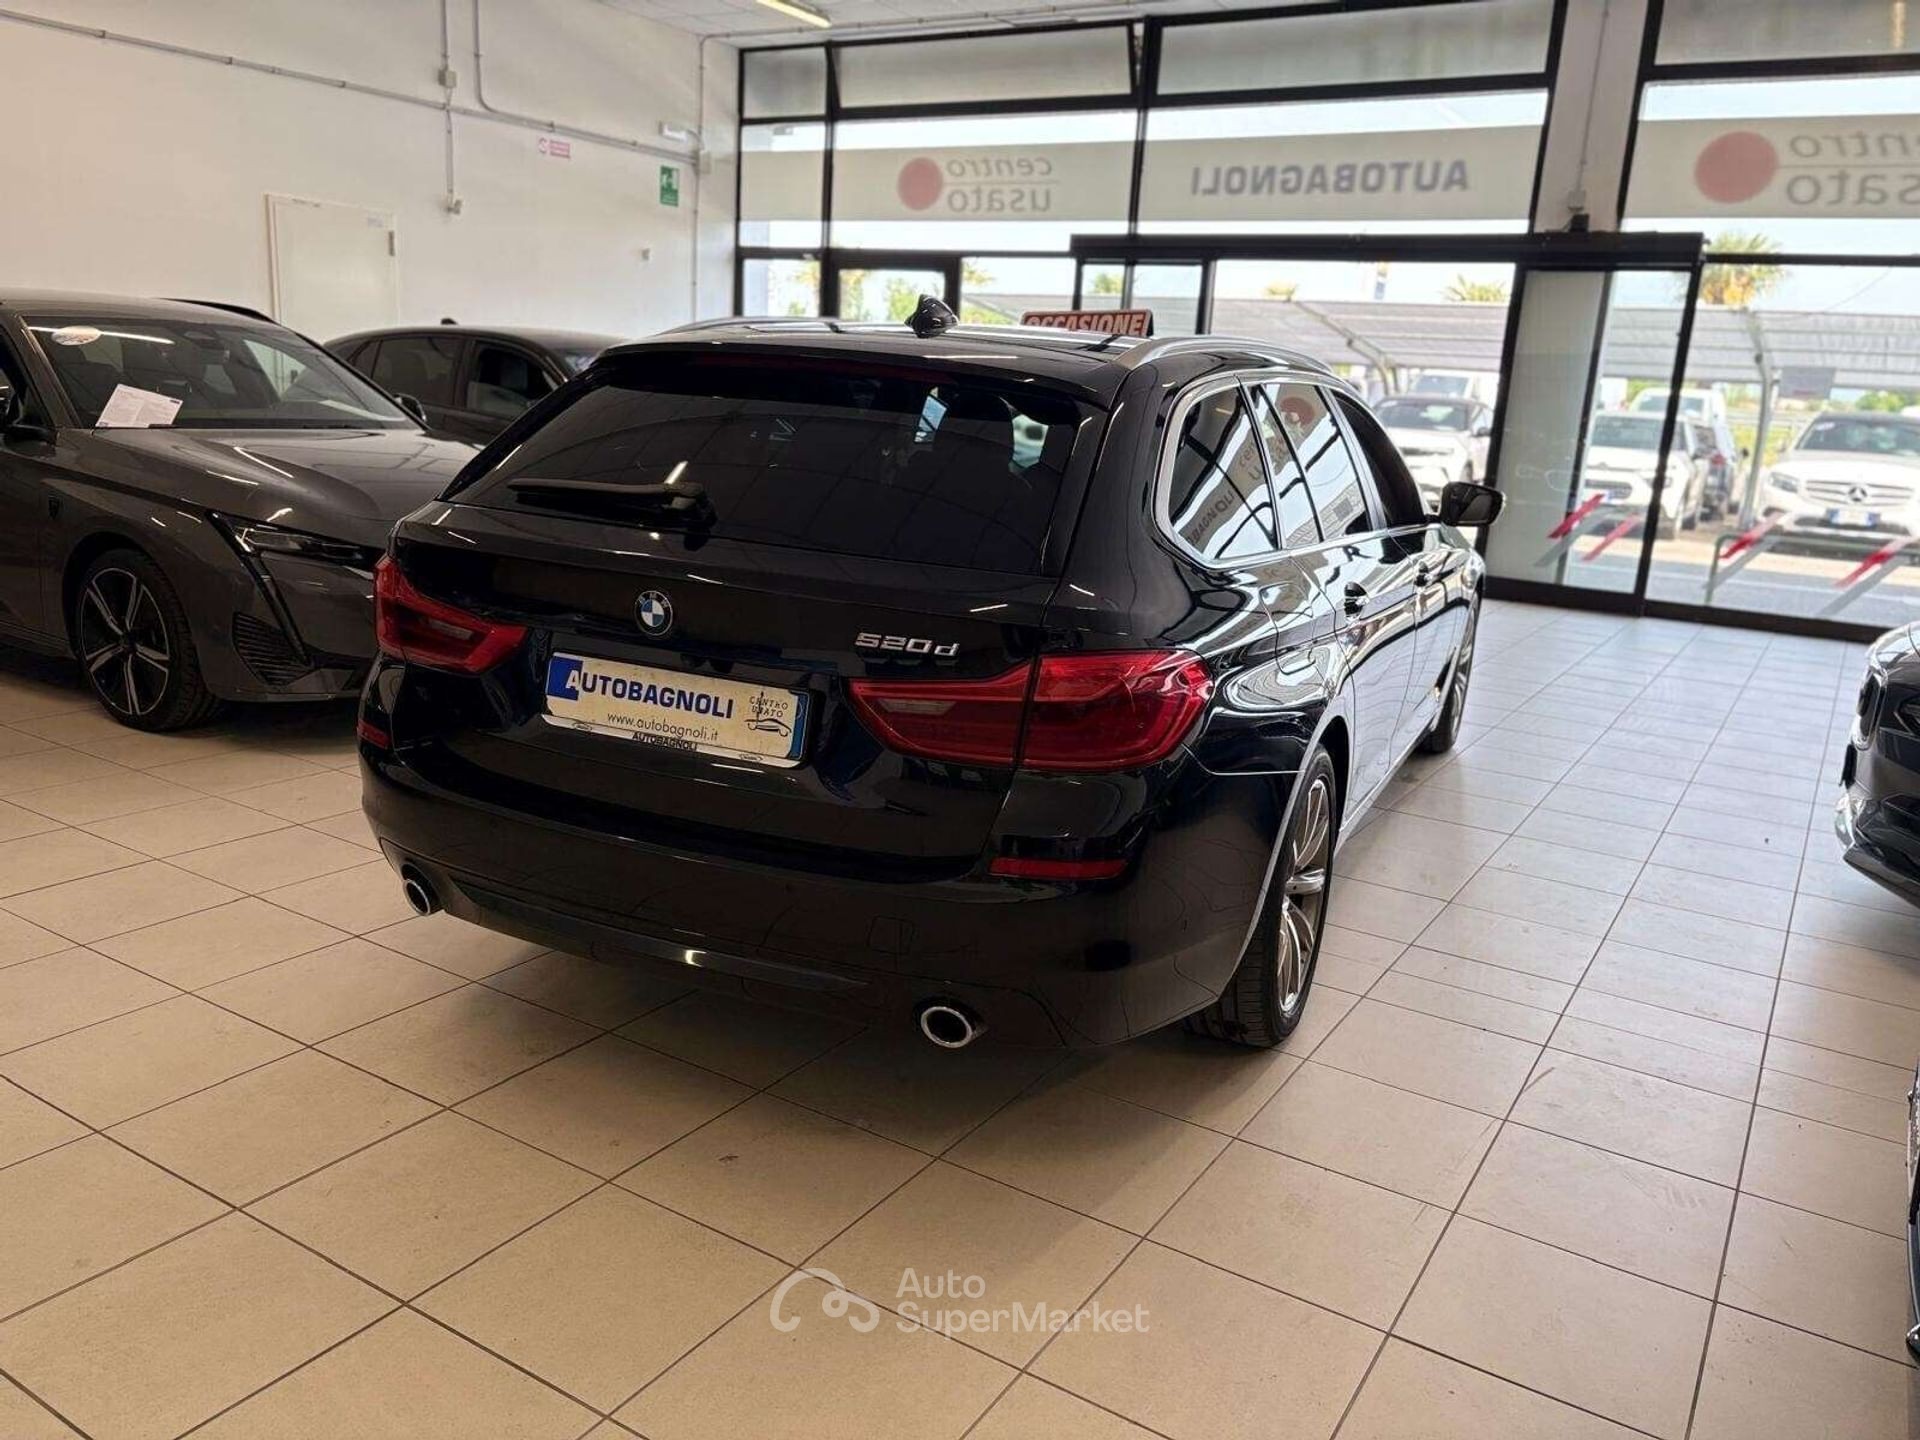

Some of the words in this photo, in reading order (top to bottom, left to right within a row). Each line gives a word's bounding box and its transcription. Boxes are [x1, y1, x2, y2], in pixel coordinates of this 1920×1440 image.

[564, 668, 734, 719] AUTOBAGNOLI
[607, 713, 719, 742] www.autobagnoli.it
[631, 730, 699, 753] AUTOBAGNOLI
